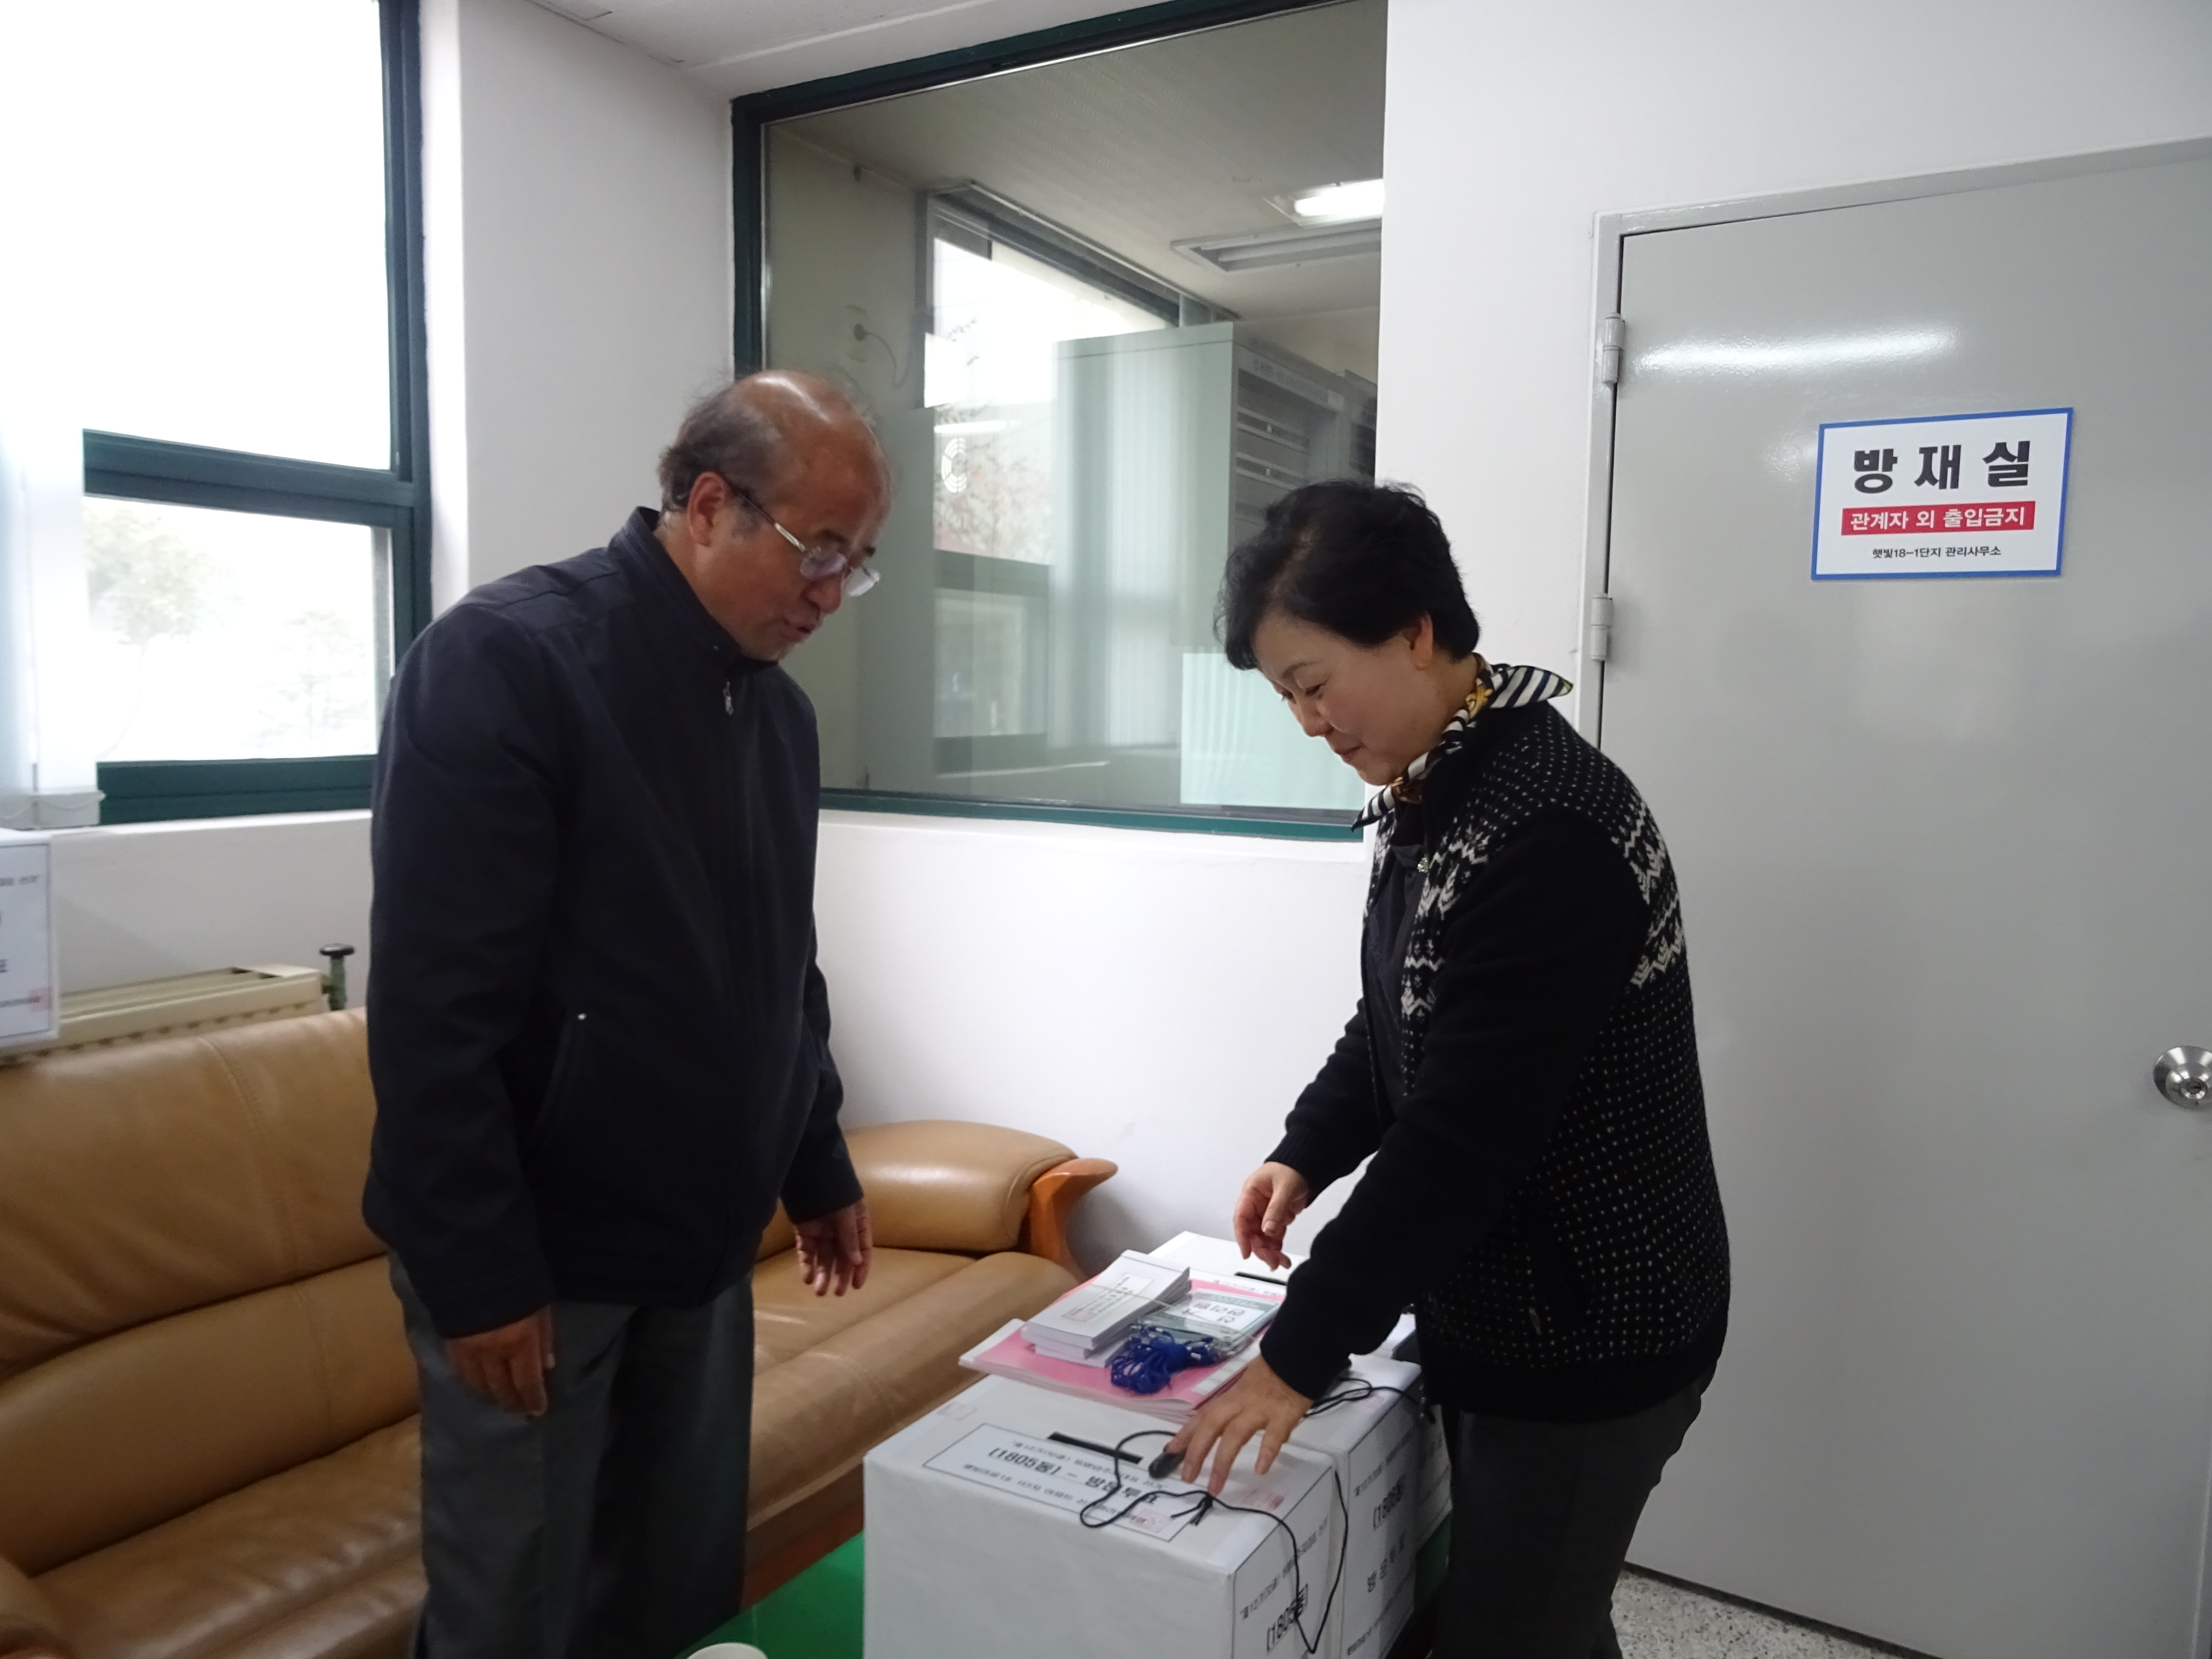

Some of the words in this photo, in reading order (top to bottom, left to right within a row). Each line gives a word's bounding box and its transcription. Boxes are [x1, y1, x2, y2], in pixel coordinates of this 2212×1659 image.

[1850, 510, 1908, 530] 관계자
[1915, 510, 1935, 528] 외
[1943, 506, 2025, 527] 출입금지
[1872, 547, 1941, 559] 햇빛18-1단지
[1945, 546, 2002, 556] 관리사무소
